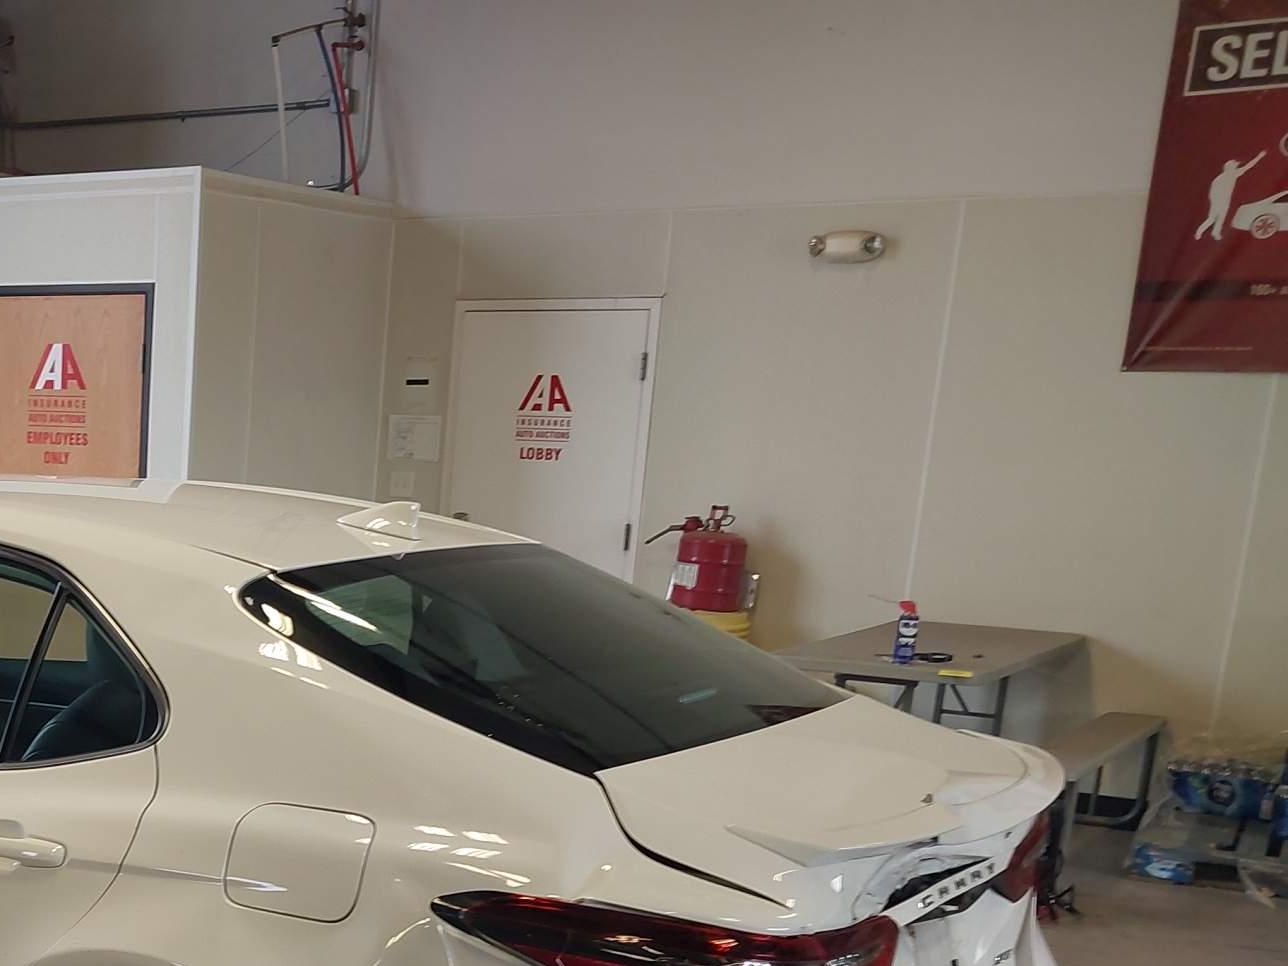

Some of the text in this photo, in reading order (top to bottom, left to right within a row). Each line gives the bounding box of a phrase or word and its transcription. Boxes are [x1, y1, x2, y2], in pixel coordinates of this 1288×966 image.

[27, 398, 87, 409] INSURANCE
[28, 413, 86, 424] AUTO AUCTIONS
[516, 418, 571, 428] INSURANCE
[26, 431, 88, 446] EMPLOYEES
[515, 430, 570, 439] AUTO AUCTIONS
[43, 451, 71, 465] ONLY
[519, 446, 562, 461] LOBBY
